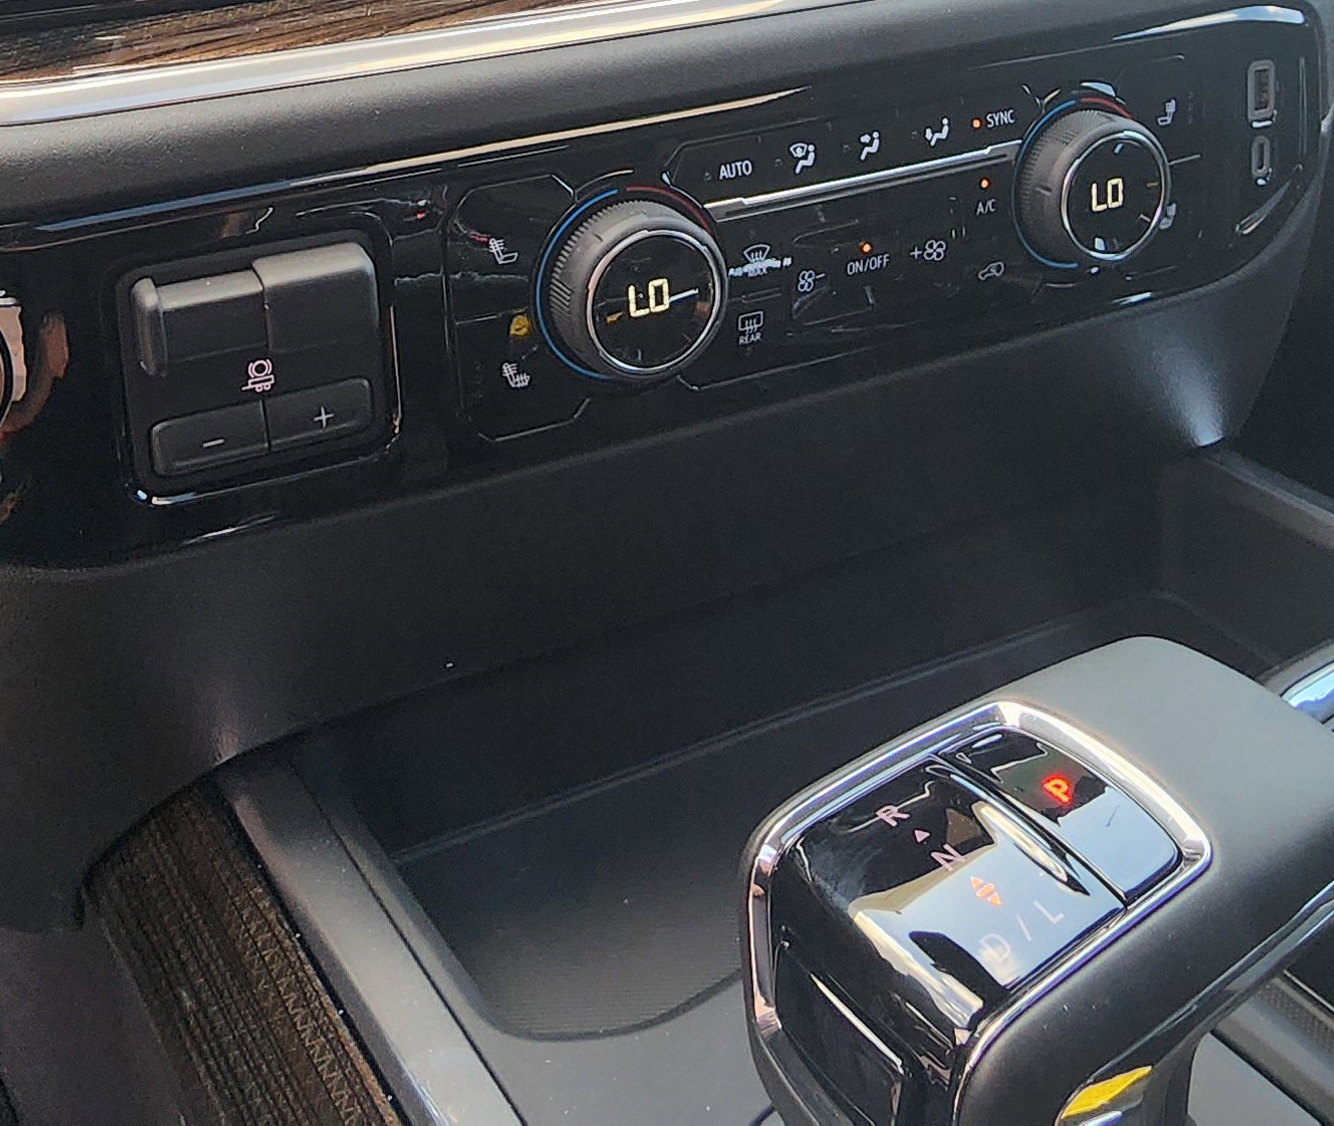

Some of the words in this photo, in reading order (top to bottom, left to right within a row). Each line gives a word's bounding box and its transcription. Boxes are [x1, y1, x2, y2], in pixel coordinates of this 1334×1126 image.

[986, 108, 1016, 128] SYNC
[719, 160, 753, 180] AUTO
[976, 199, 996, 215] A/C
[1091, 178, 1124, 213] LO
[846, 252, 891, 276] ON/OFF
[627, 278, 670, 318] LO
[738, 331, 762, 345] REAR
[1042, 776, 1072, 804] P
[875, 805, 911, 827] R
[930, 843, 967, 872] N
